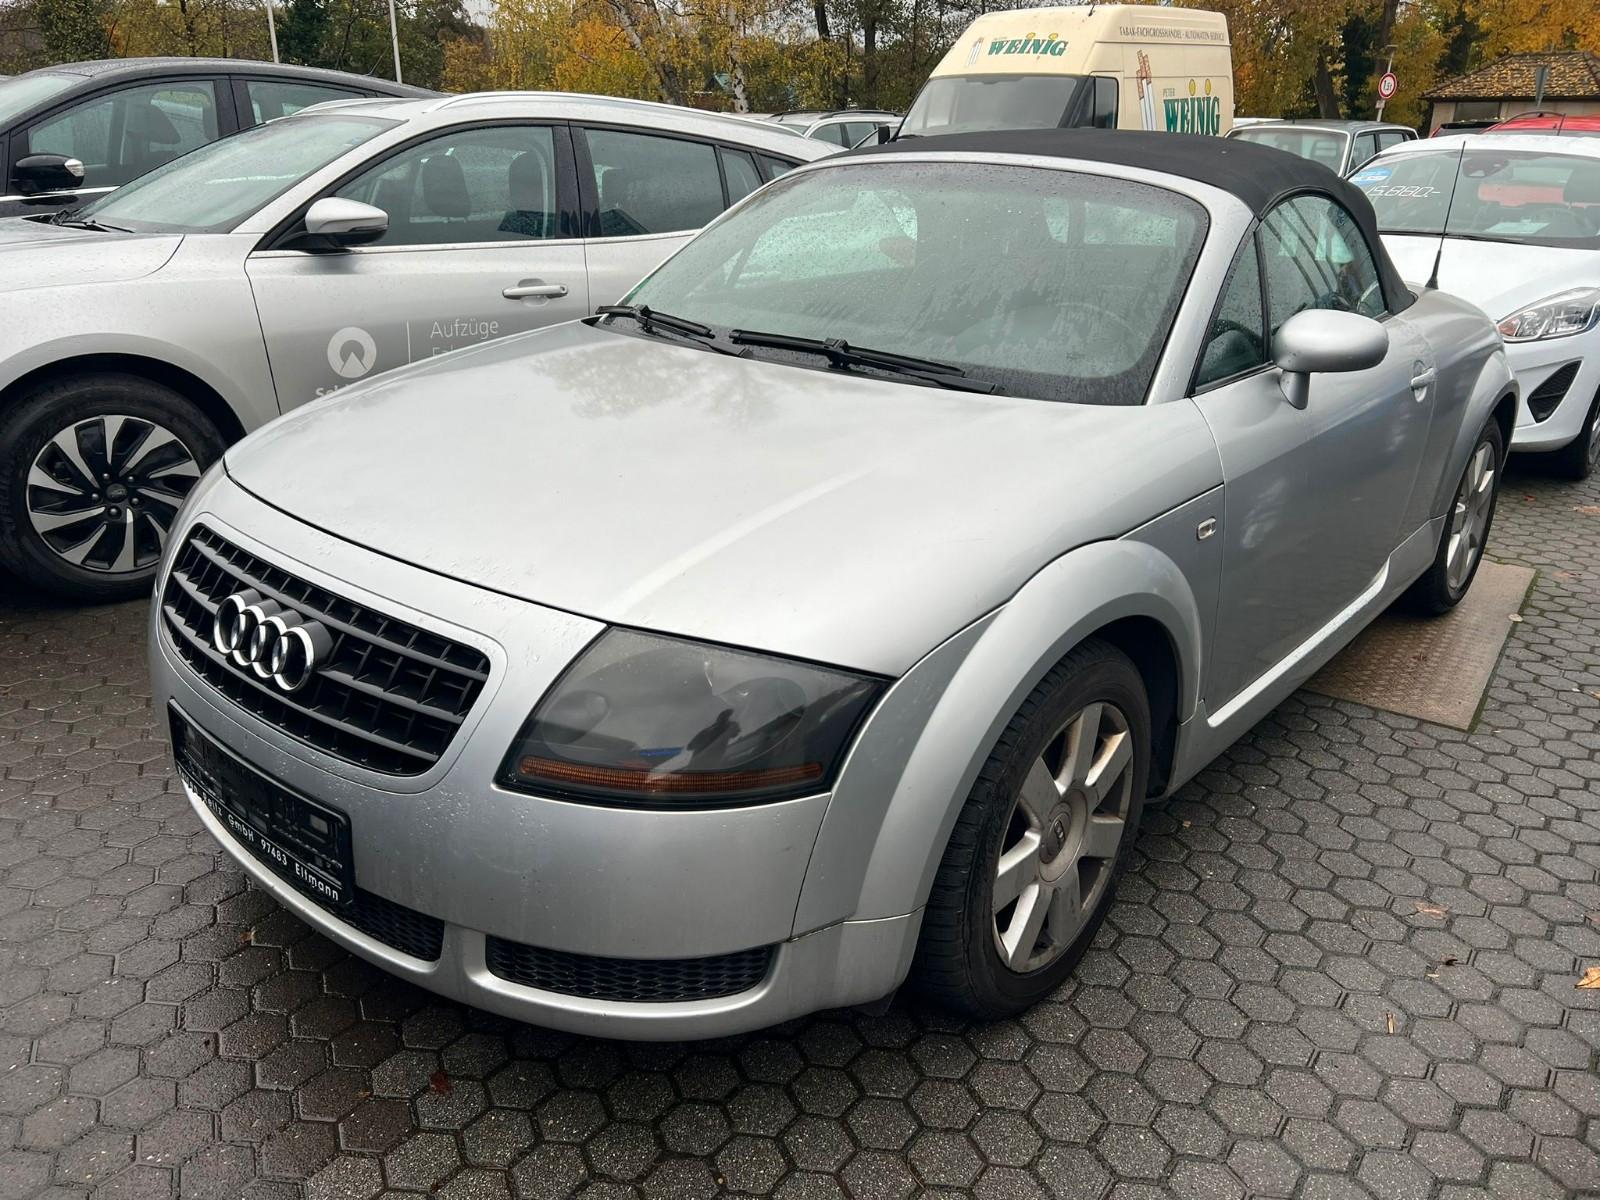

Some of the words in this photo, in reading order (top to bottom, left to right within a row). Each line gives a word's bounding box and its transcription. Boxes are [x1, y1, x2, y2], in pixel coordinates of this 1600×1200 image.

[988, 33, 1069, 56] WEINIG
[1163, 80, 1221, 135] WEINIG
[430, 318, 499, 340] Aufzüge
[228, 814, 254, 842] GmbH
[260, 839, 288, 866] 97483
[295, 862, 339, 901] Eltmann
